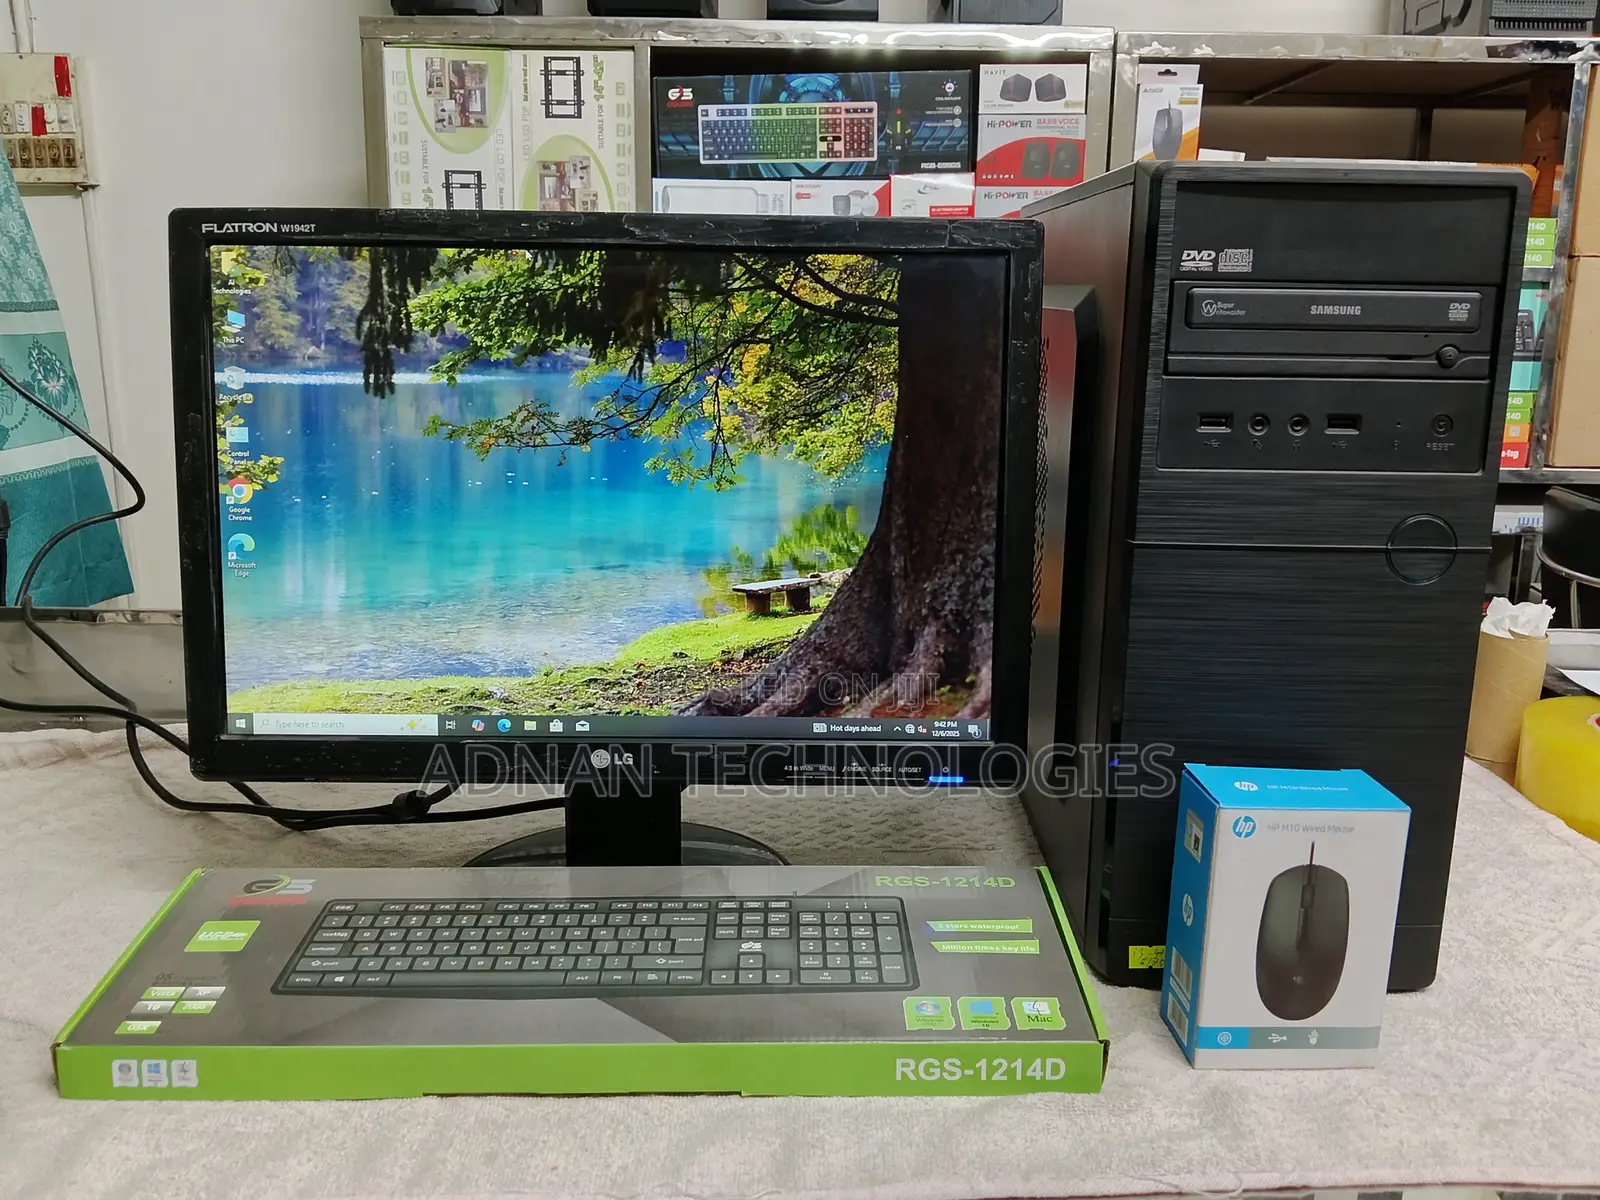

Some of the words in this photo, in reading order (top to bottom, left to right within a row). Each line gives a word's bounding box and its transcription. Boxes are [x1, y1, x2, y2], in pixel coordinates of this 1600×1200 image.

[986, 119, 1032, 128] Hi-POWER
[421, 140, 429, 170] SUITABLE
[983, 191, 1028, 200] Hi-POWER
[201, 222, 278, 234] FLATRON
[280, 224, 316, 233] W1942T
[1181, 250, 1216, 261] DVD
[212, 287, 252, 296] Technologies
[1310, 305, 1362, 316] SAMSUNG
[235, 336, 245, 344] PC
[219, 393, 243, 401] Recycle
[228, 506, 251, 515] Google
[228, 561, 257, 569] Microsoft
[234, 570, 250, 578] Edge
[276, 720, 292, 728] Type
[294, 720, 310, 728] here
[321, 720, 344, 728] search
[830, 724, 843, 732] Hot
[844, 724, 860, 734] days
[861, 724, 882, 732] ahead
[931, 730, 960, 738] 12/6/2025
[614, 754, 634, 765] LG
[1233, 816, 1256, 838] hp
[1281, 824, 1300, 832] M10
[1302, 824, 1325, 833] Wired
[1327, 825, 1355, 833] Mouse
[875, 875, 1017, 889] RGS-1214D
[1027, 1014, 1052, 1023] Mac
[895, 1057, 1067, 1081] RGS-1214D
